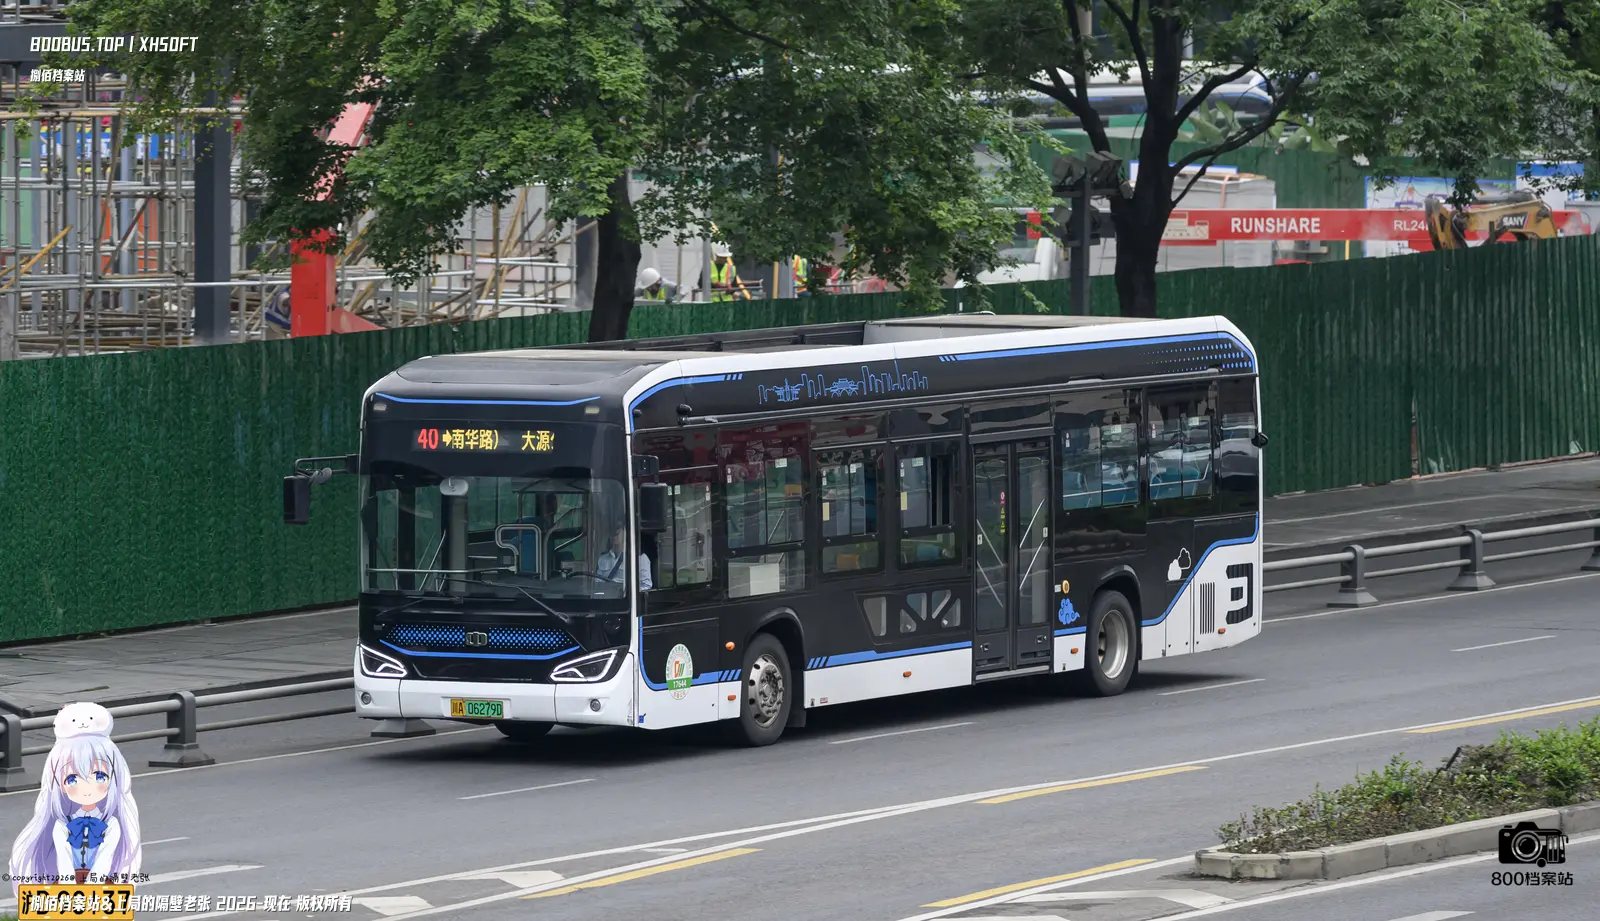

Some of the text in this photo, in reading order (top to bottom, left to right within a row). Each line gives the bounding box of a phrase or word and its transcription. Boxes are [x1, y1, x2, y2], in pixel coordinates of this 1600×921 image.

[1230, 217, 1321, 234] RUNSHARE
[1503, 216, 1525, 226] SANY
[417, 428, 439, 450] 40
